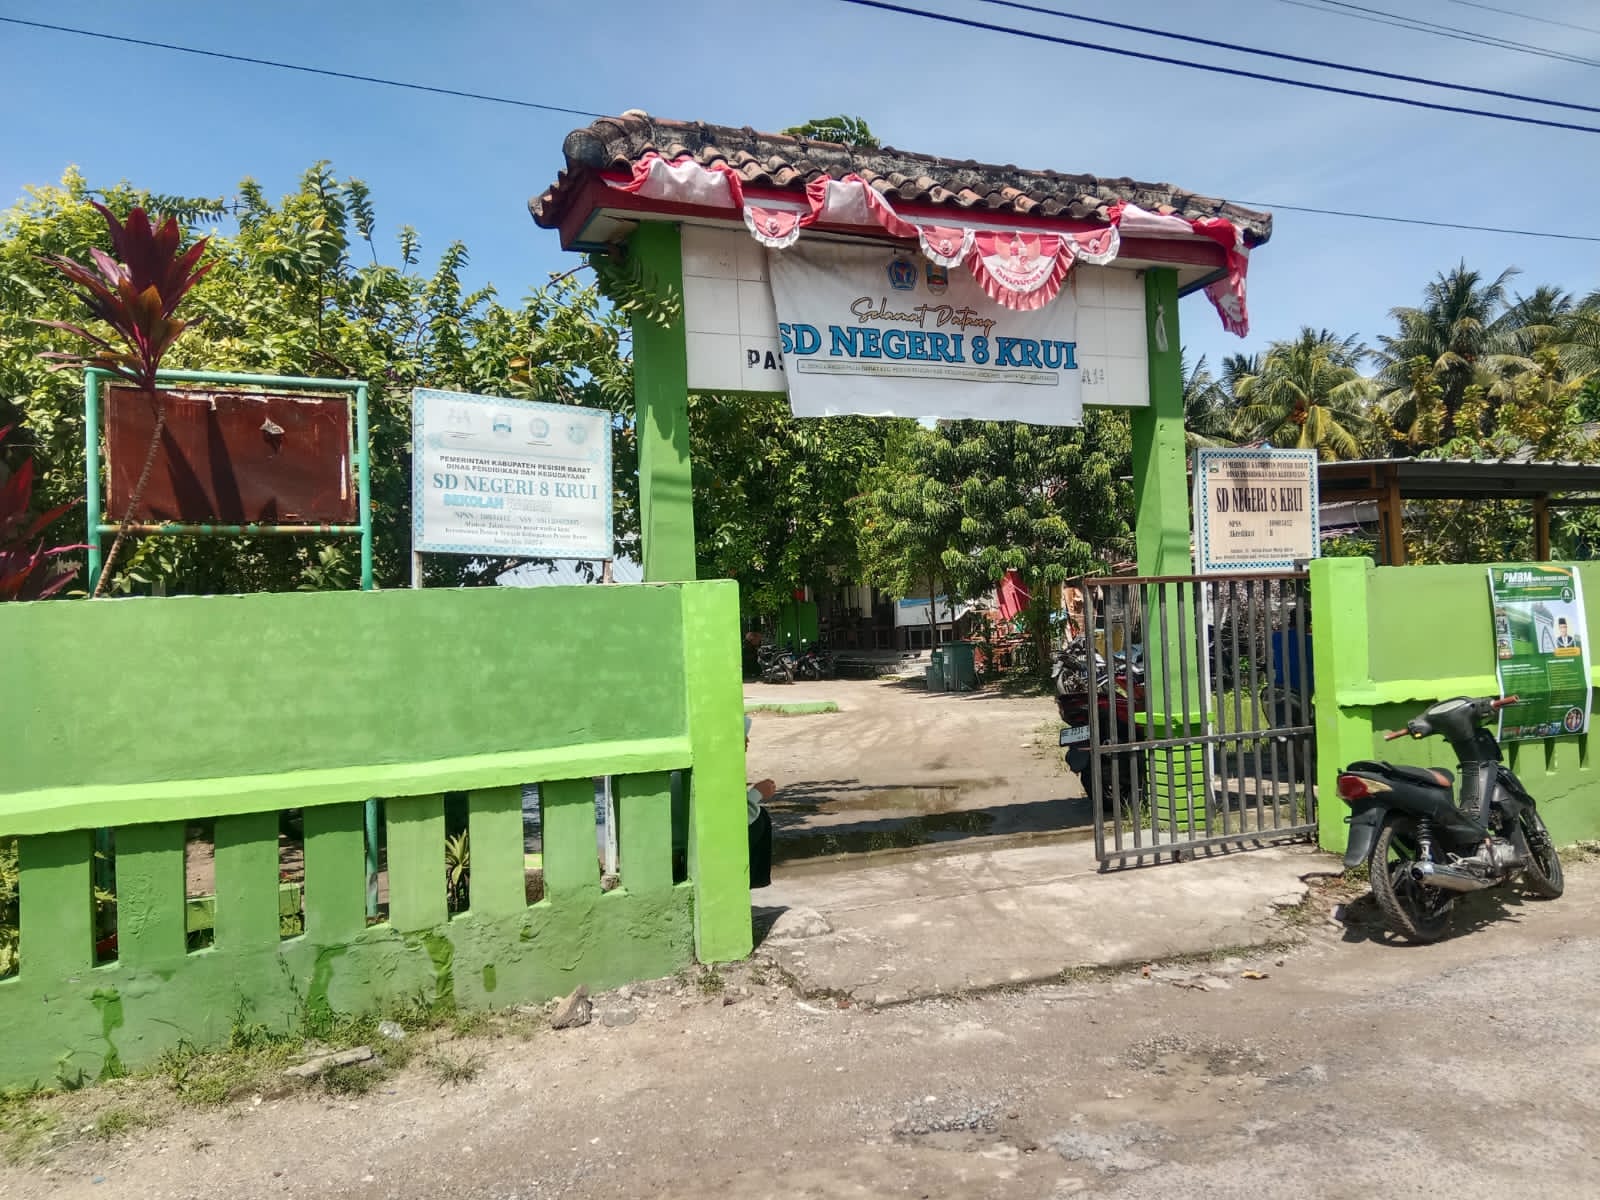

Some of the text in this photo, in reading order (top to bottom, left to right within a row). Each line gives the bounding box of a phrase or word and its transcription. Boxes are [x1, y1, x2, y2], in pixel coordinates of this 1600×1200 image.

[850, 296, 996, 337] Selamat Datang
[777, 322, 1078, 369] SD NEGERI 8 KRUI
[440, 455, 490, 466] PEMERINTAH
[491, 459, 536, 470] KABUPATEN
[538, 463, 566, 472] PESISIR
[446, 463, 470, 471] DINAS
[472, 465, 519, 475] PENDIDIKAN
[520, 469, 536, 477] DAN
[433, 473, 599, 500] SD NEGERI 8 KRUI
[1216, 488, 1303, 512] SD NEGERI 8 KRUI
[1503, 572, 1532, 583] PMBM
